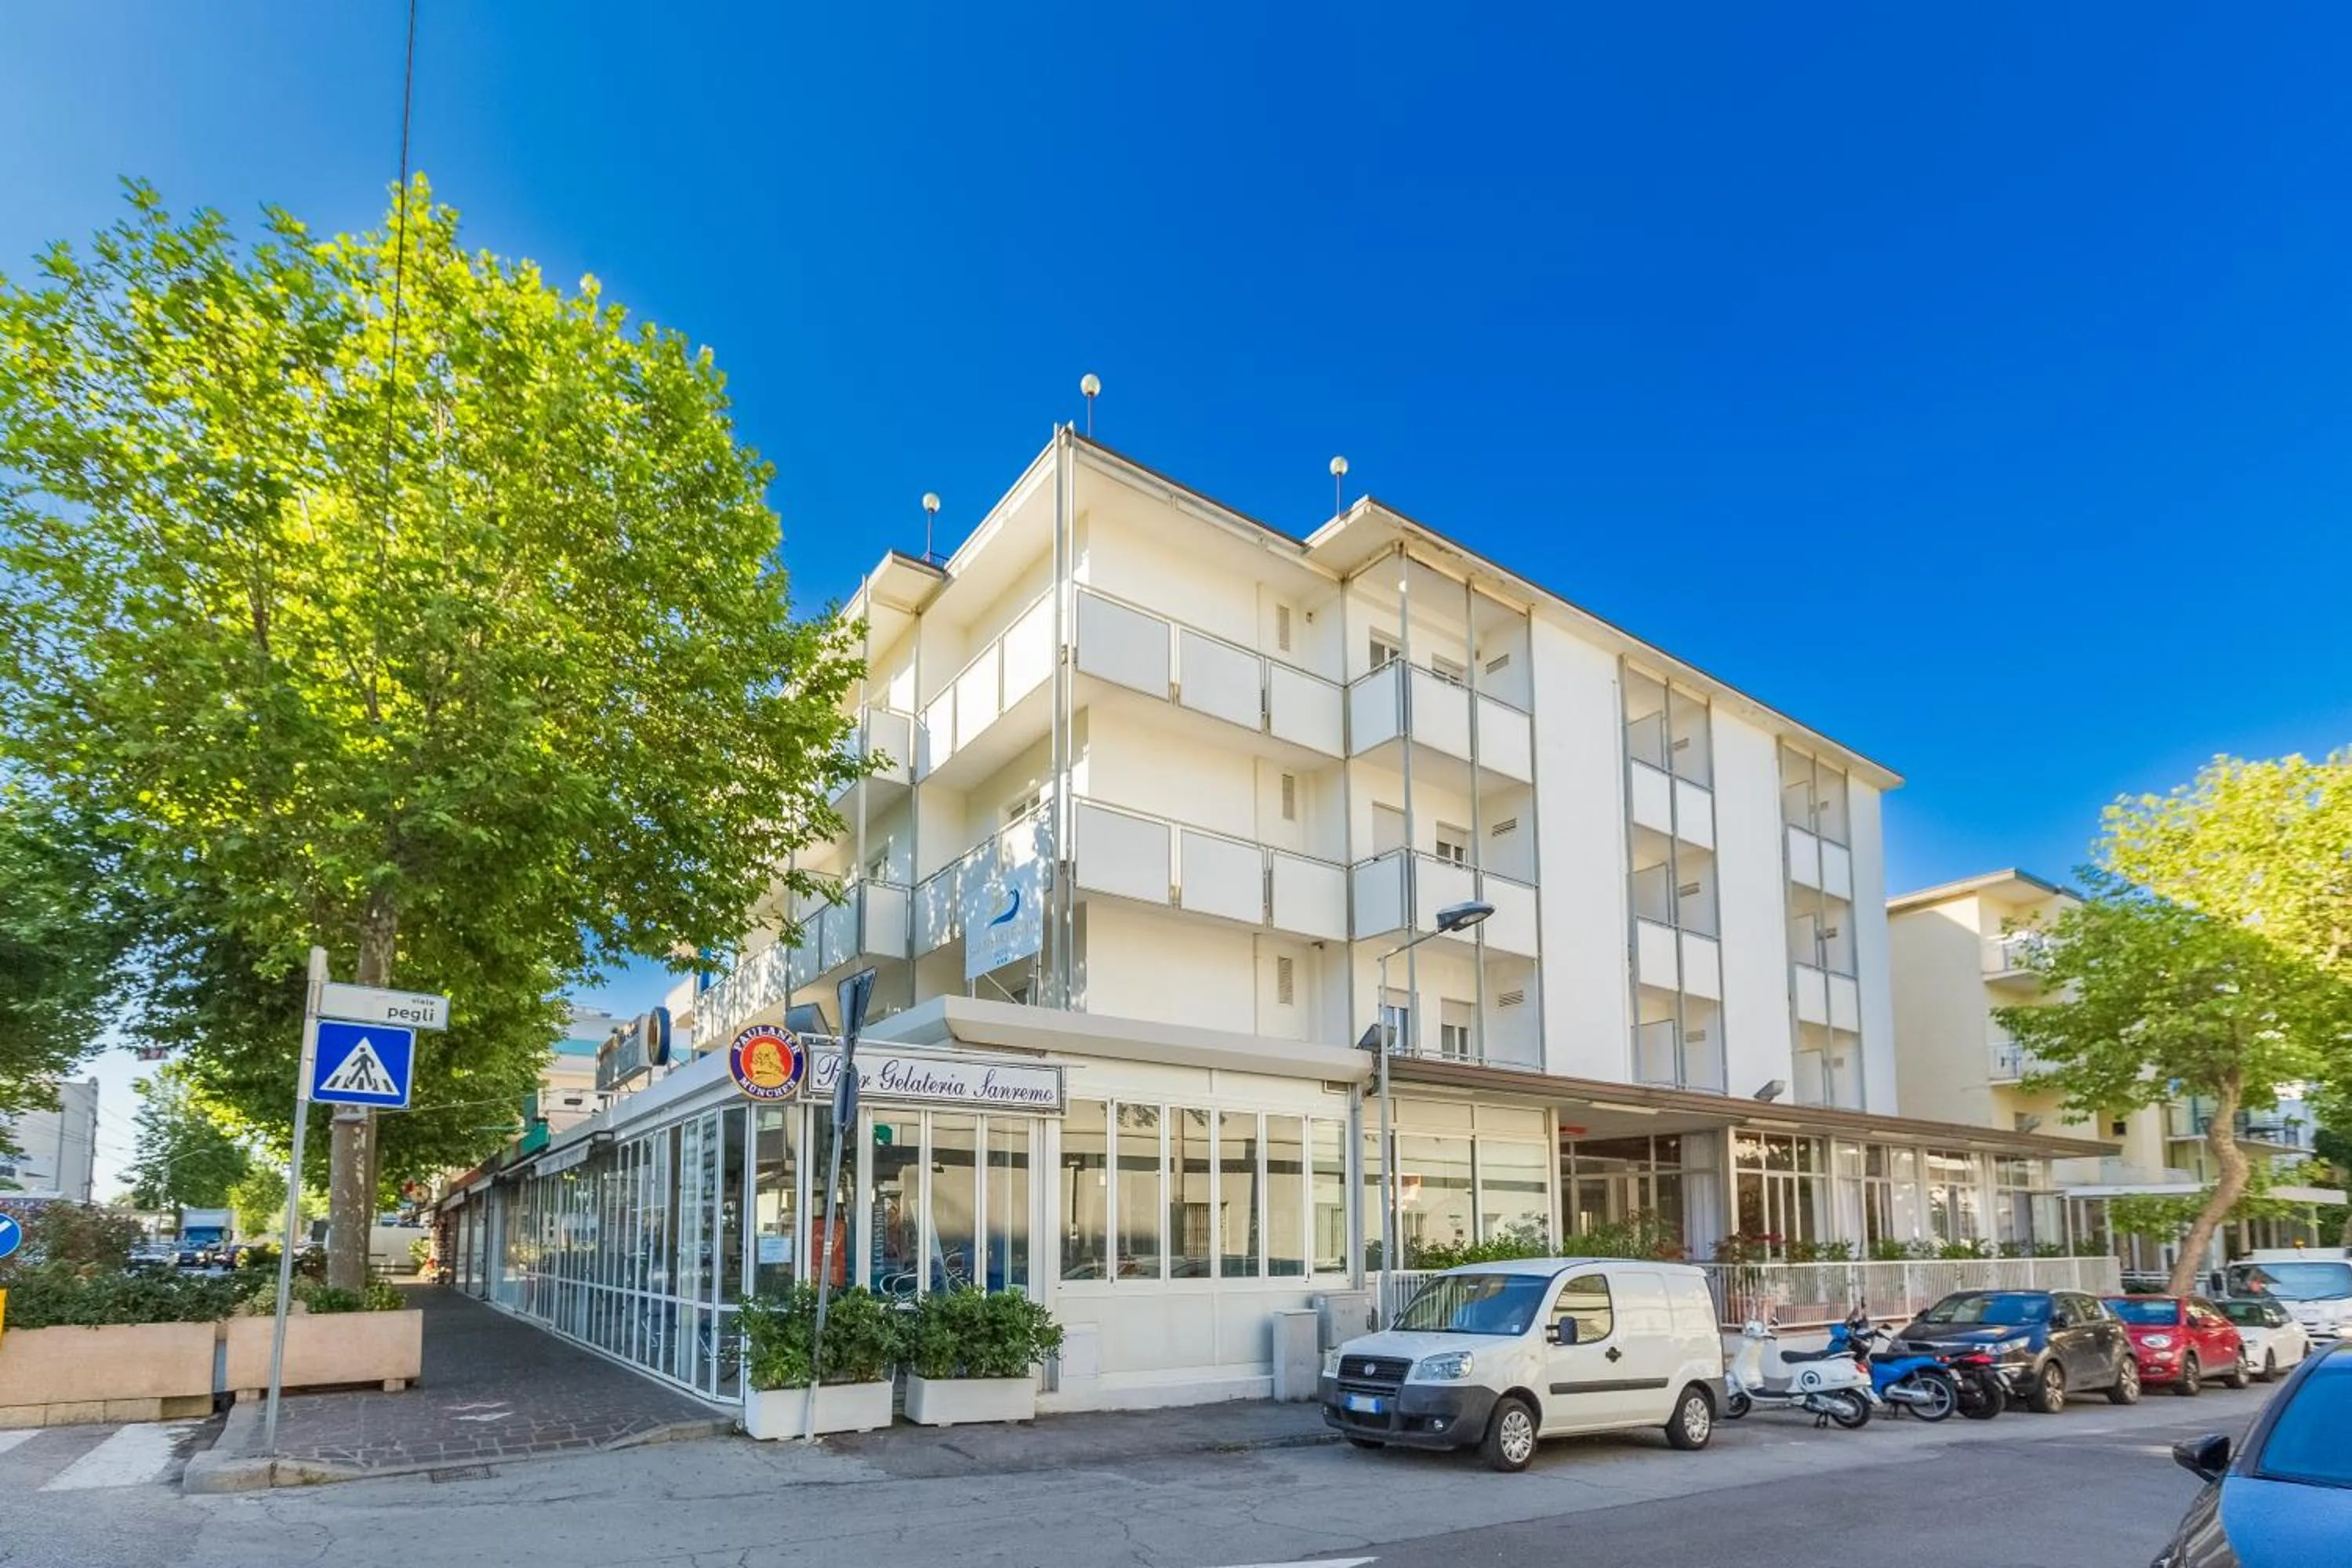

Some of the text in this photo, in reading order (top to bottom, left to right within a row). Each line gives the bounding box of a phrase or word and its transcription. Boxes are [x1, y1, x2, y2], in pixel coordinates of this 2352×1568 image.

[387, 1007, 434, 1022] pegli
[733, 1026, 800, 1054] PAULANER
[878, 1059, 966, 1095] Gelateria
[974, 1068, 1054, 1102] Sanremo
